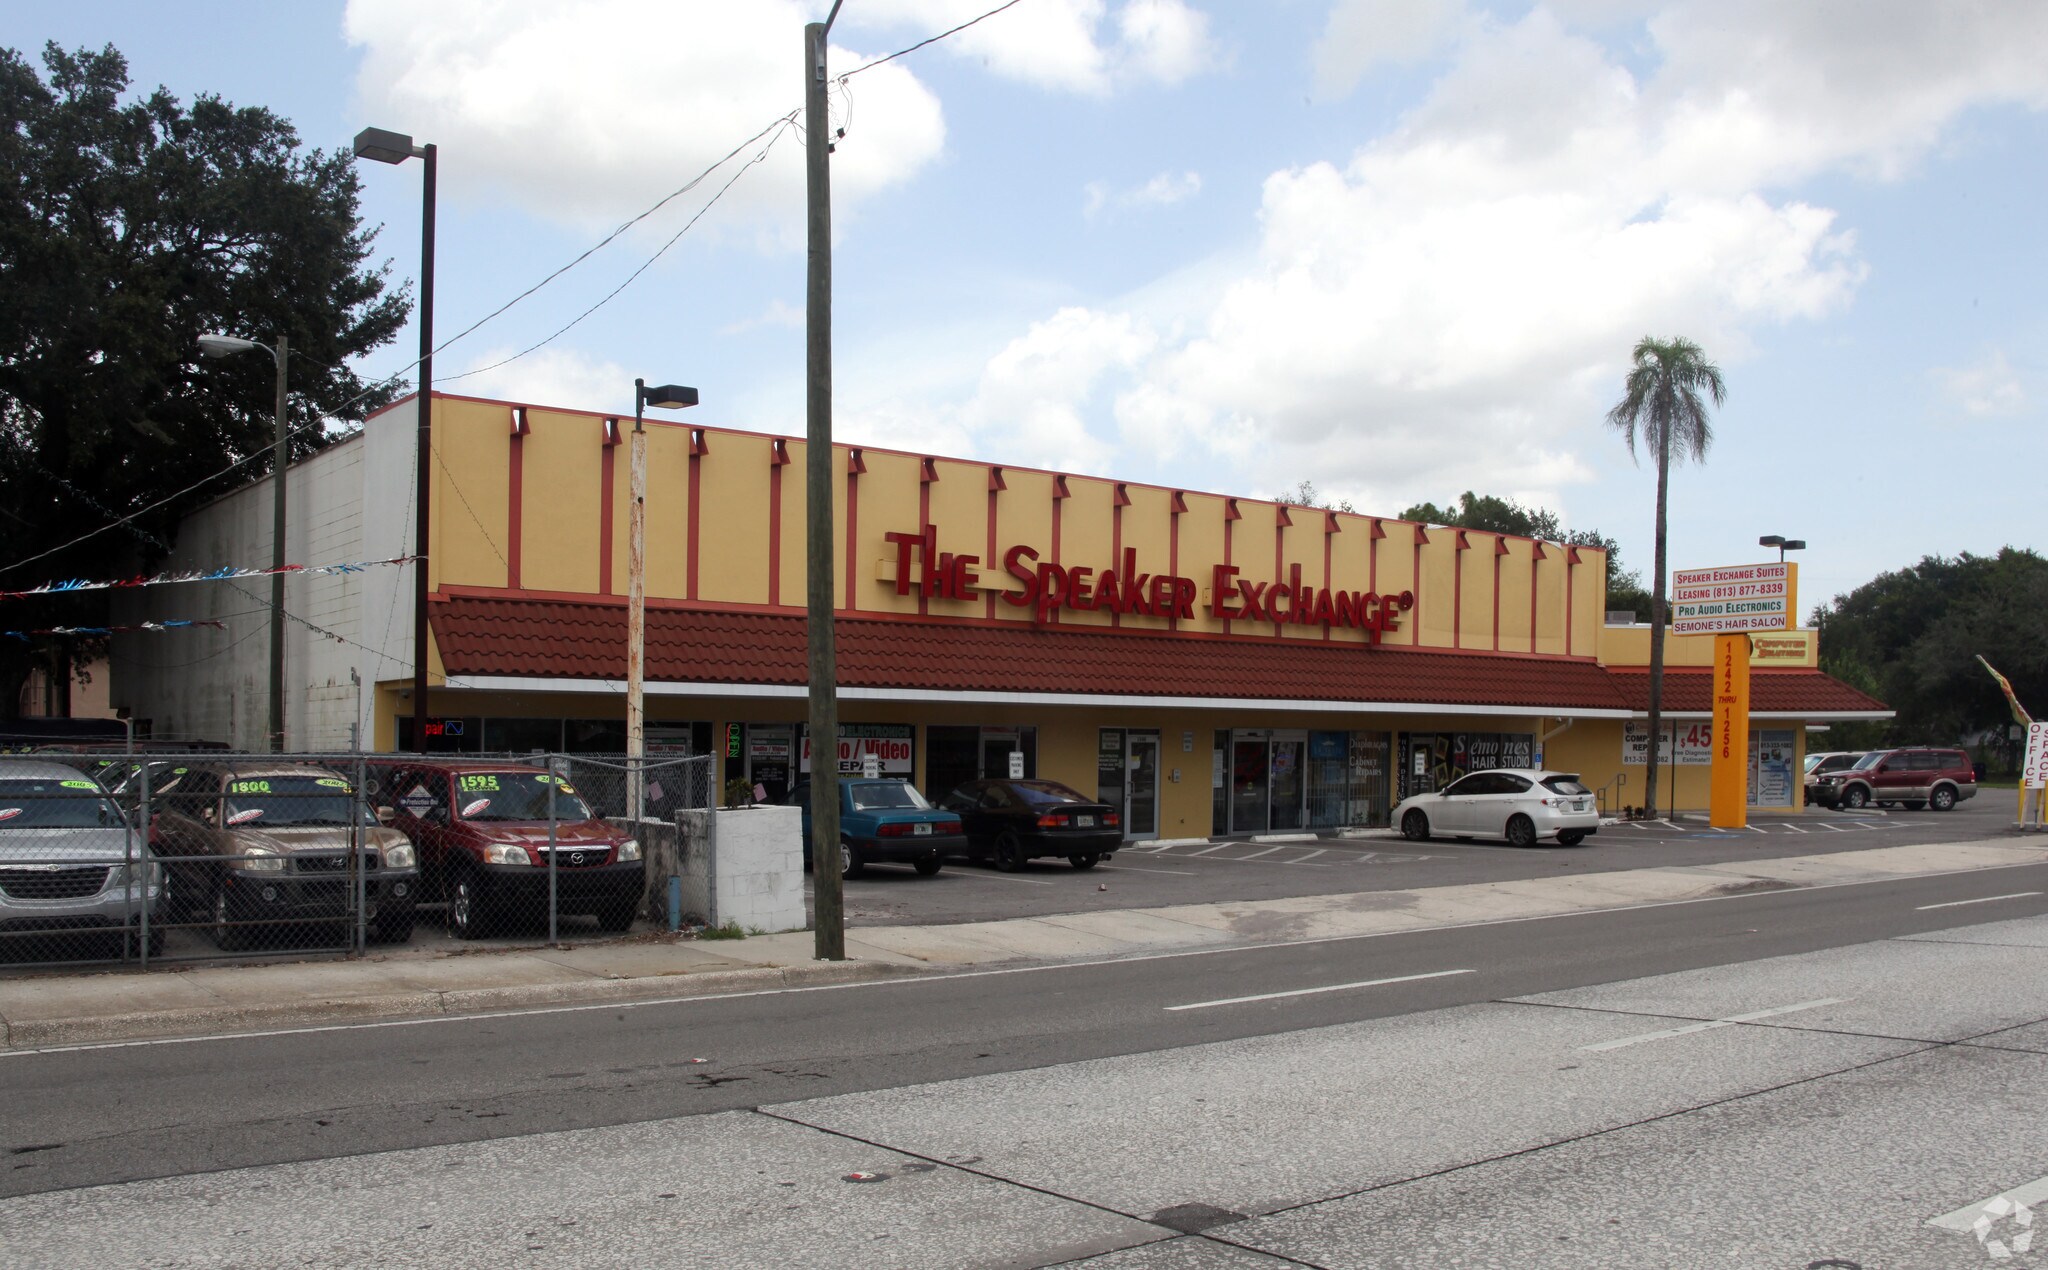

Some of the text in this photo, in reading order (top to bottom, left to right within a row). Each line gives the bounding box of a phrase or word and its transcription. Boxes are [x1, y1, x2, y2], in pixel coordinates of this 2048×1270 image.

[1677, 567, 1785, 584] SPEAKER EXCHANGE SUITES
[1678, 583, 1783, 600] LEASING (813) 877-8339
[1678, 601, 1782, 616] PRO AUDIO ELECTRONICS
[1674, 617, 1785, 632] SEMONE'S HAIR SALON
[1718, 696, 1737, 704] THRU
[425, 721, 444, 736] pair
[1625, 735, 1668, 743] COMPER
[1471, 756, 1497, 769] HAIR
[1502, 755, 1530, 768] STUDIO
[460, 775, 498, 787] 1595
